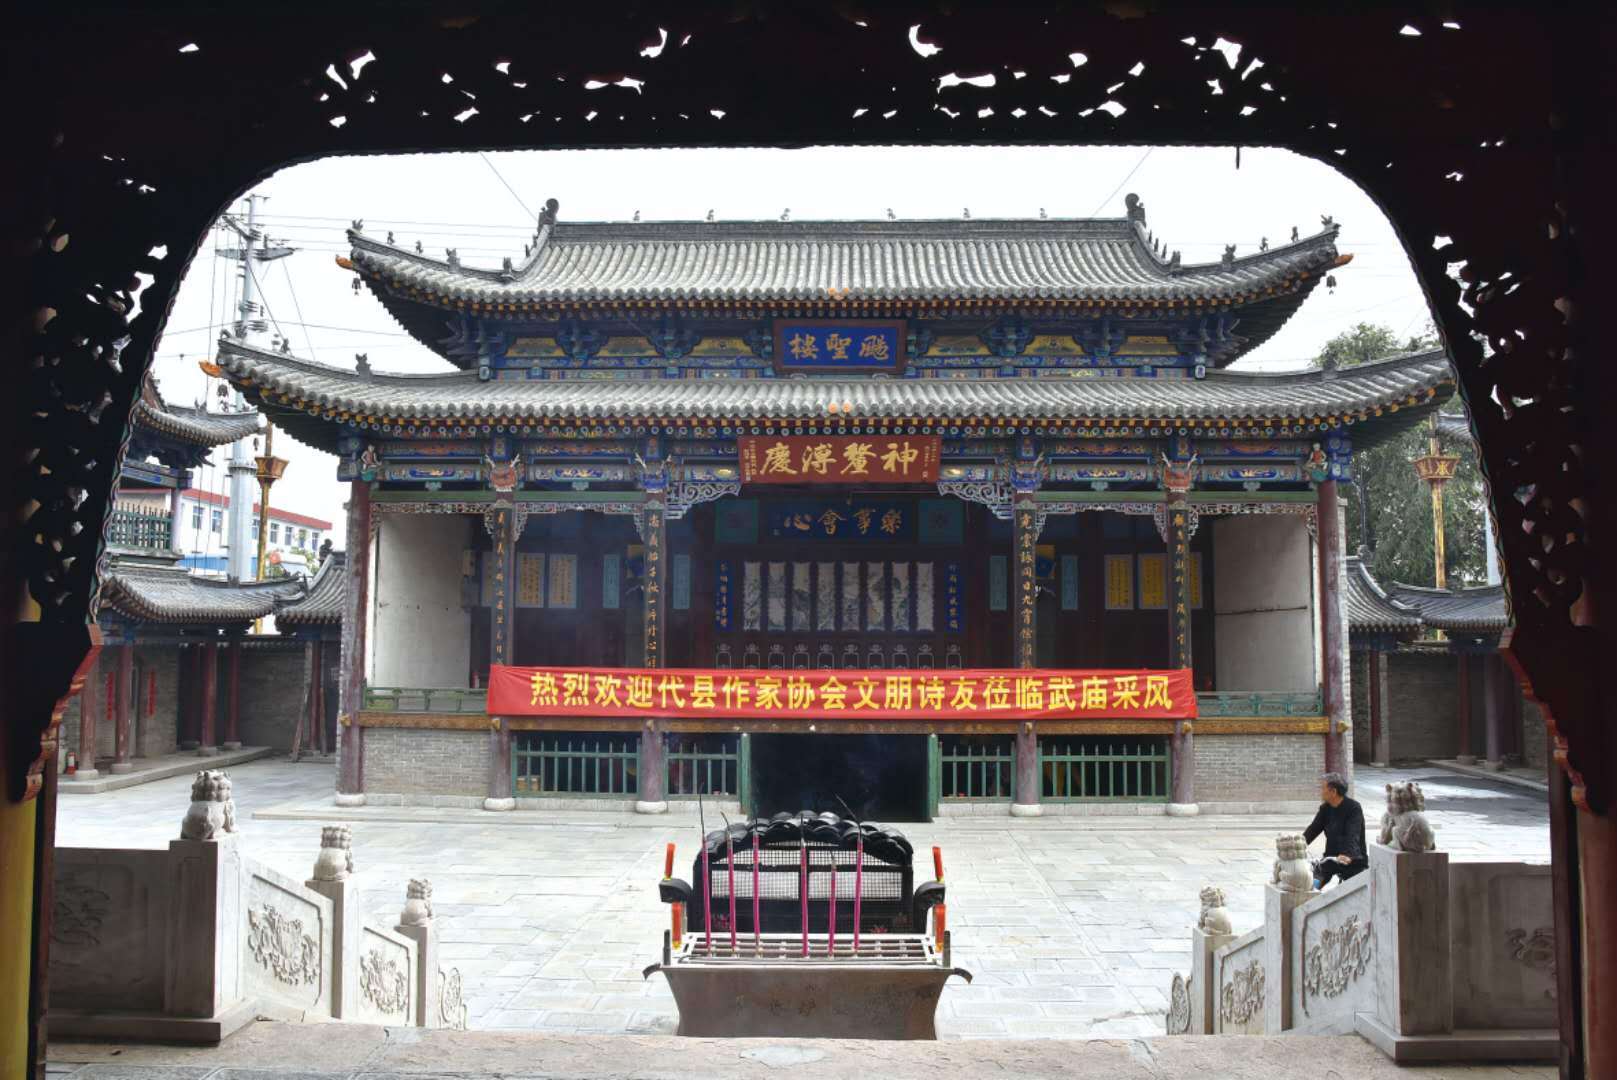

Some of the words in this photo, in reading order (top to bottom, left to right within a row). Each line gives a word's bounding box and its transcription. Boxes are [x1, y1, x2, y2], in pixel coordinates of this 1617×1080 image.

[529, 671, 1174, 711] 热烈欢迎代县作家协会文朋诗友莅临武庙采风
